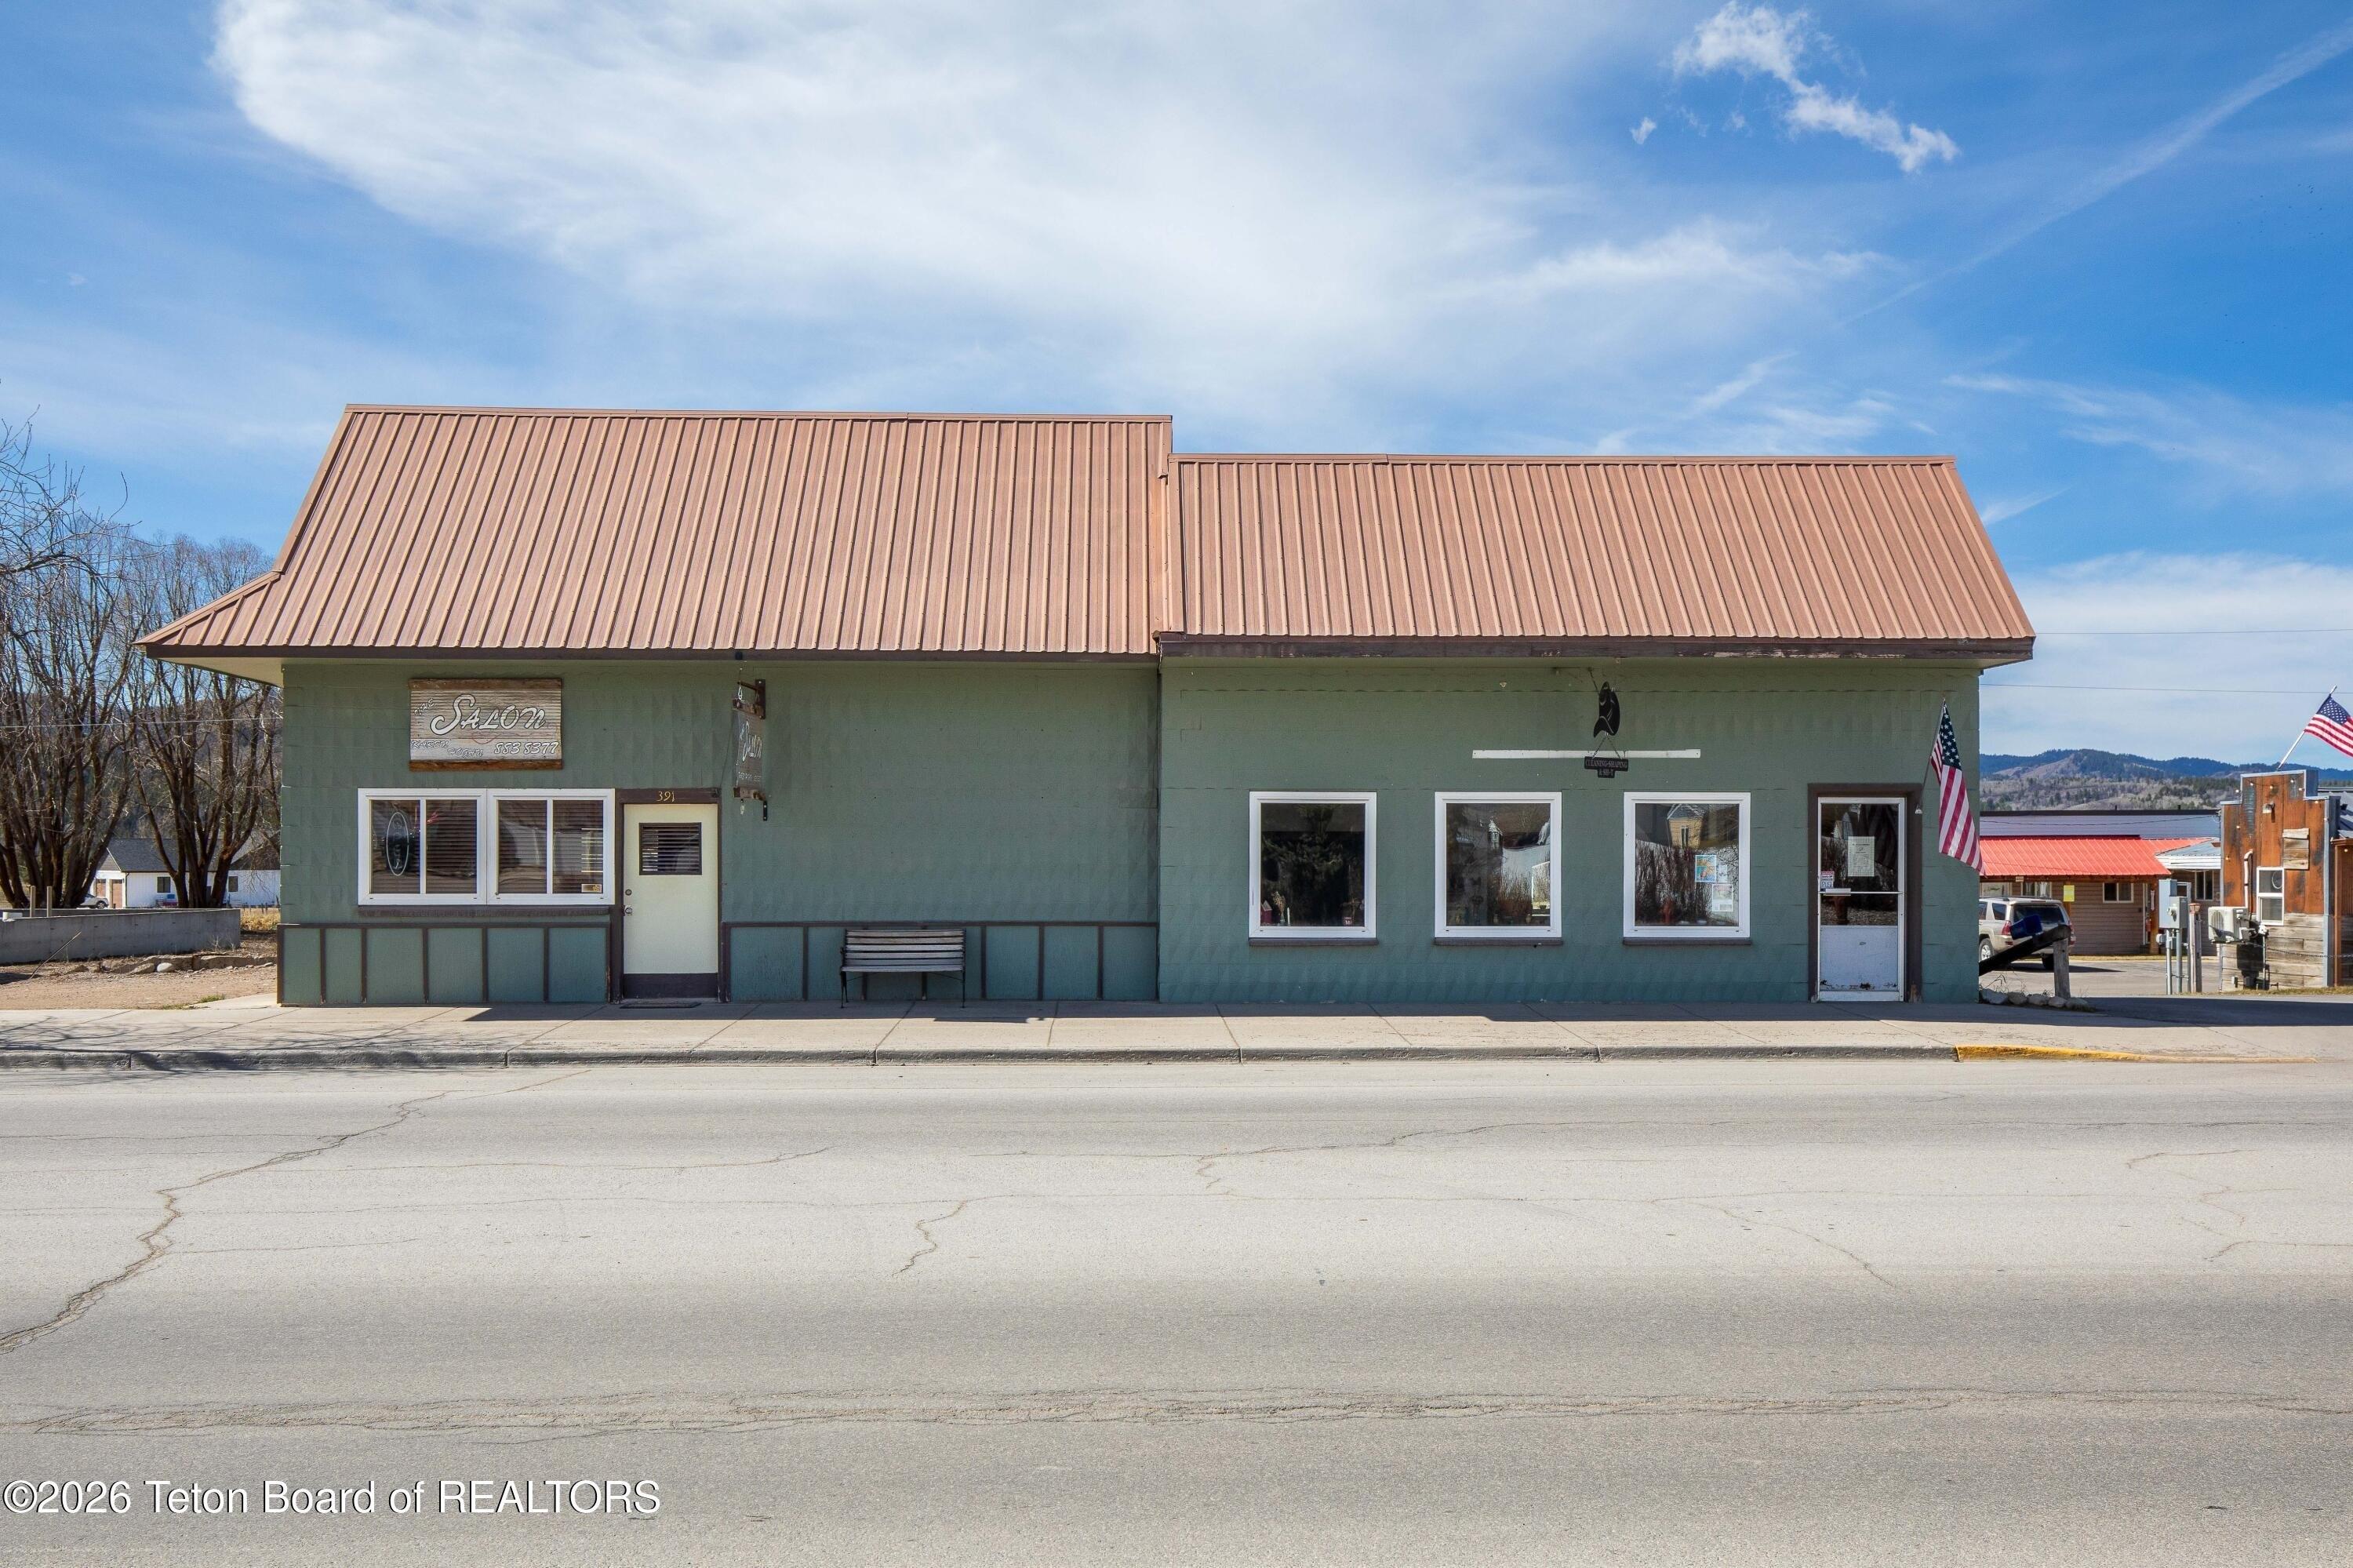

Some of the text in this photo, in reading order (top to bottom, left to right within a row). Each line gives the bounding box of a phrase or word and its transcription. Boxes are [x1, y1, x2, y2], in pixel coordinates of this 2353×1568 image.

[493, 741, 559, 755] 883 8377
[656, 791, 675, 802] 391
